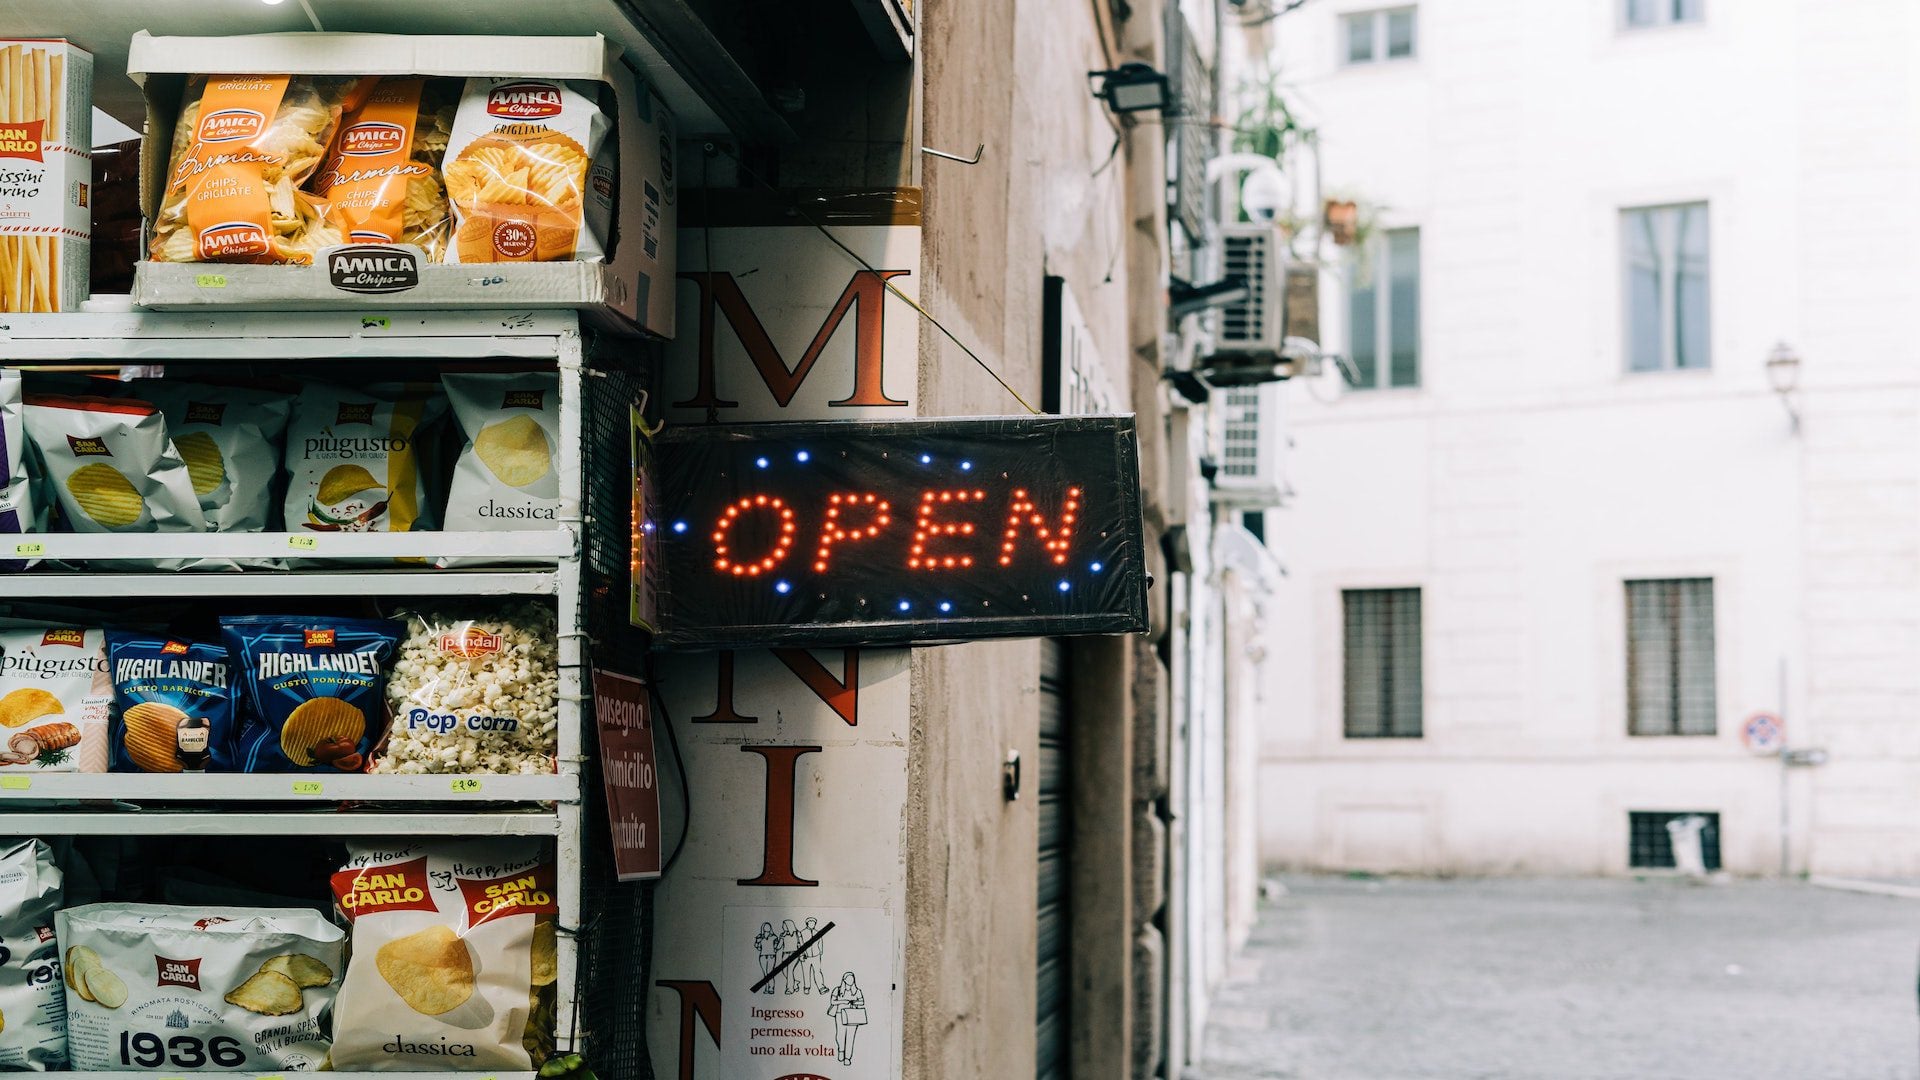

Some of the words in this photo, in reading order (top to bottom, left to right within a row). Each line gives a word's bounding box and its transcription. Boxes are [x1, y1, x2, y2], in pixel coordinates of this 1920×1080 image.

[217, 83, 272, 91] GRIGLIATE
[492, 91, 561, 105] AMICA
[508, 104, 542, 115] Chips
[204, 117, 259, 130] AMICA
[494, 124, 549, 135] GRIGLIATA
[215, 128, 239, 136] Chips
[344, 131, 400, 143] AMICA
[0, 140, 38, 152] ARLO
[357, 141, 383, 150] Chips
[172, 142, 283, 193] Barman
[0, 168, 46, 183] issini
[206, 178, 238, 189] CHIPS
[197, 186, 252, 201] GRIGLIATE
[346, 191, 378, 200] CHIPS
[205, 231, 260, 250] AMICA
[501, 228, 529, 242] -30%
[222, 245, 249, 256] Chips
[332, 255, 415, 275] AMICA
[356, 272, 394, 288] Chips
[73, 446, 106, 454] CARLO
[76, 440, 97, 448] SAN
[304, 428, 406, 460] piùgusto
[479, 499, 555, 520] classica
[708, 485, 1084, 579] OPEN
[46, 634, 81, 642] CARLO
[115, 658, 228, 690] HIGHLANDER
[124, 685, 158, 695] GUSTO
[273, 679, 308, 691] GUSTO
[312, 677, 374, 688] POMODORO
[408, 708, 457, 734] Pop
[467, 715, 518, 732] corn
[598, 694, 644, 737] onsegna
[453, 863, 501, 877] Happy
[352, 873, 406, 891] SAN
[484, 876, 537, 898] SAN
[341, 887, 424, 908] CARLO
[473, 891, 551, 914] CARLO
[26, 961, 63, 987] 193
[166, 964, 189, 973] SAN
[160, 971, 197, 983] CARLO
[131, 997, 171, 1016] RINOMATA
[174, 997, 225, 1024] ROSTICCERIA
[751, 1006, 804, 1021] Ingresso
[750, 1027, 815, 1040] permesso,
[119, 1030, 247, 1069] 1936
[256, 1043, 273, 1056] CON
[273, 1037, 283, 1051] LA
[284, 1031, 321, 1046] BUCCIA
[382, 1034, 477, 1057] classica
[750, 1046, 775, 1055] uno
[779, 1043, 801, 1056] alla
[804, 1044, 835, 1057] volta
